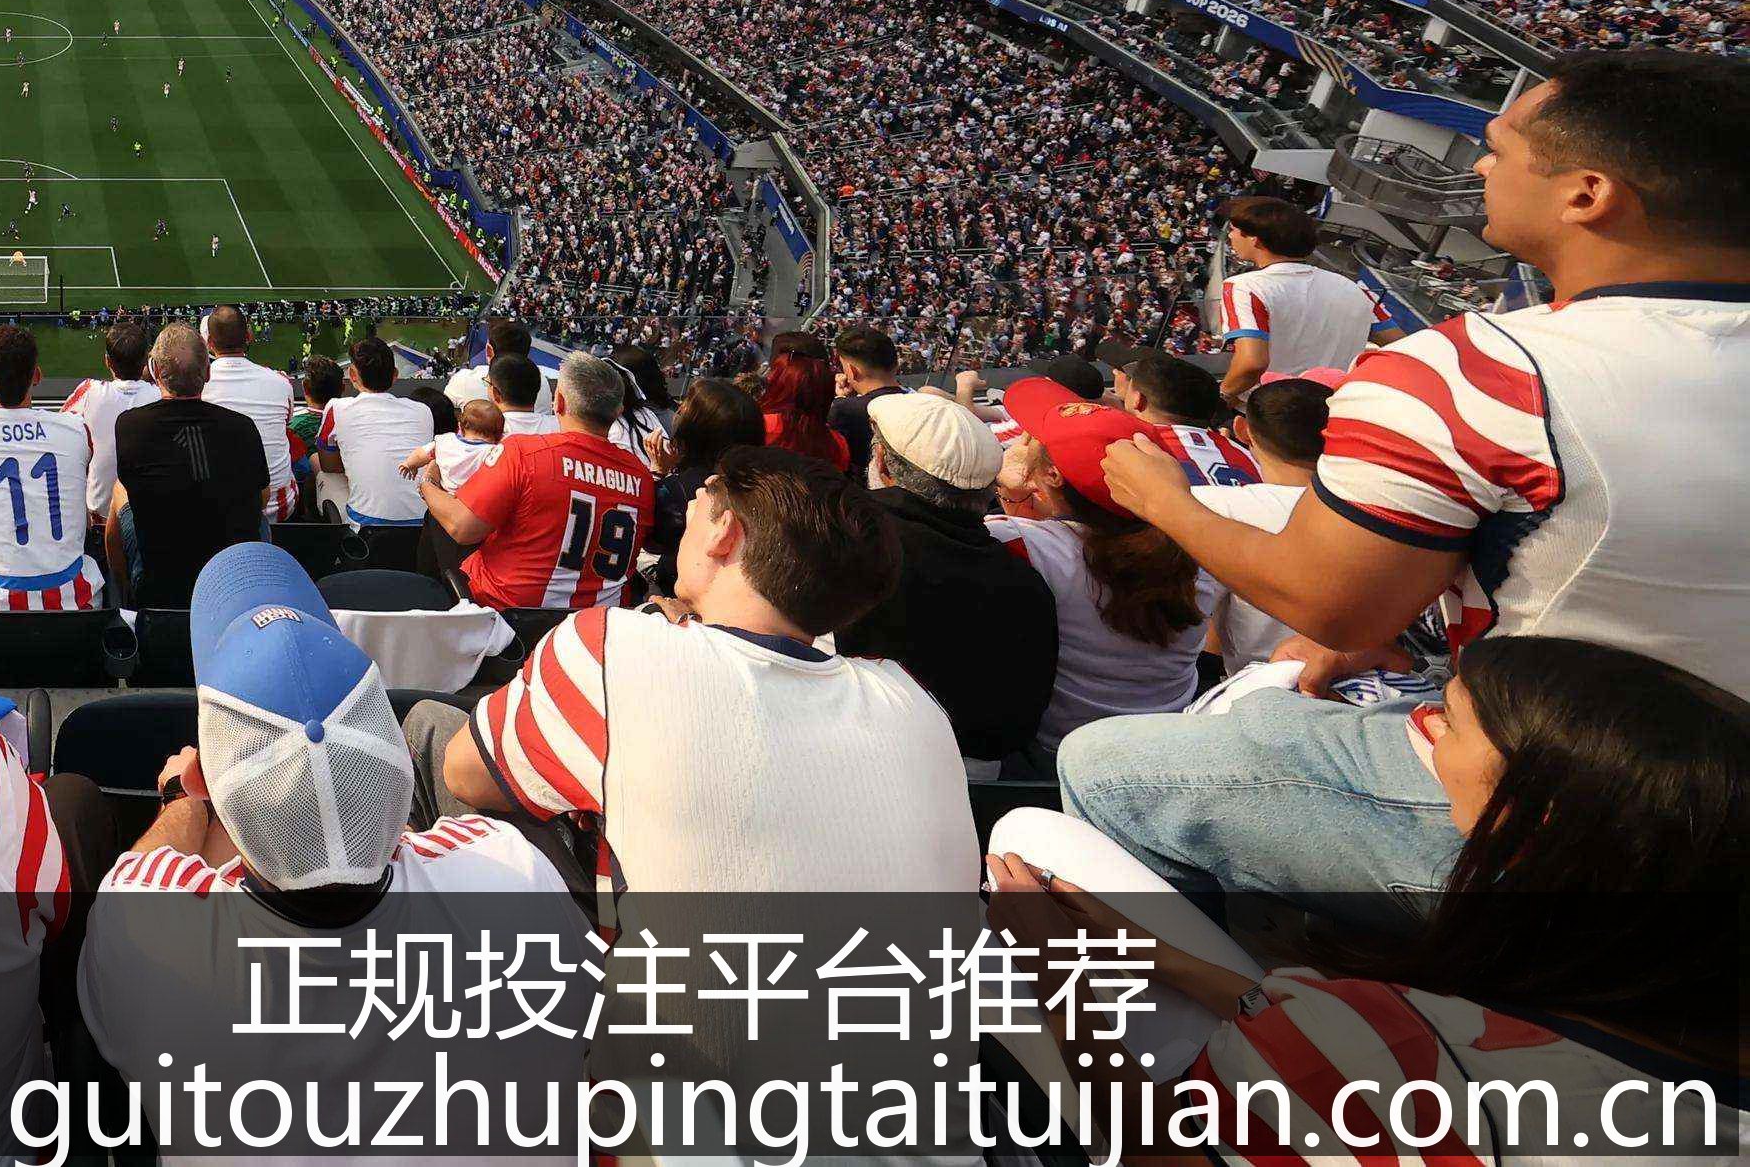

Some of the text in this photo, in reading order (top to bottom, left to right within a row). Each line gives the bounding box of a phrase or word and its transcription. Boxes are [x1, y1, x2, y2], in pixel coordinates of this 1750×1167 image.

[1207, 0, 1249, 28] 2026
[2, 421, 47, 442] SOSA
[562, 456, 643, 497] PARAGUAY
[558, 490, 639, 581] 19
